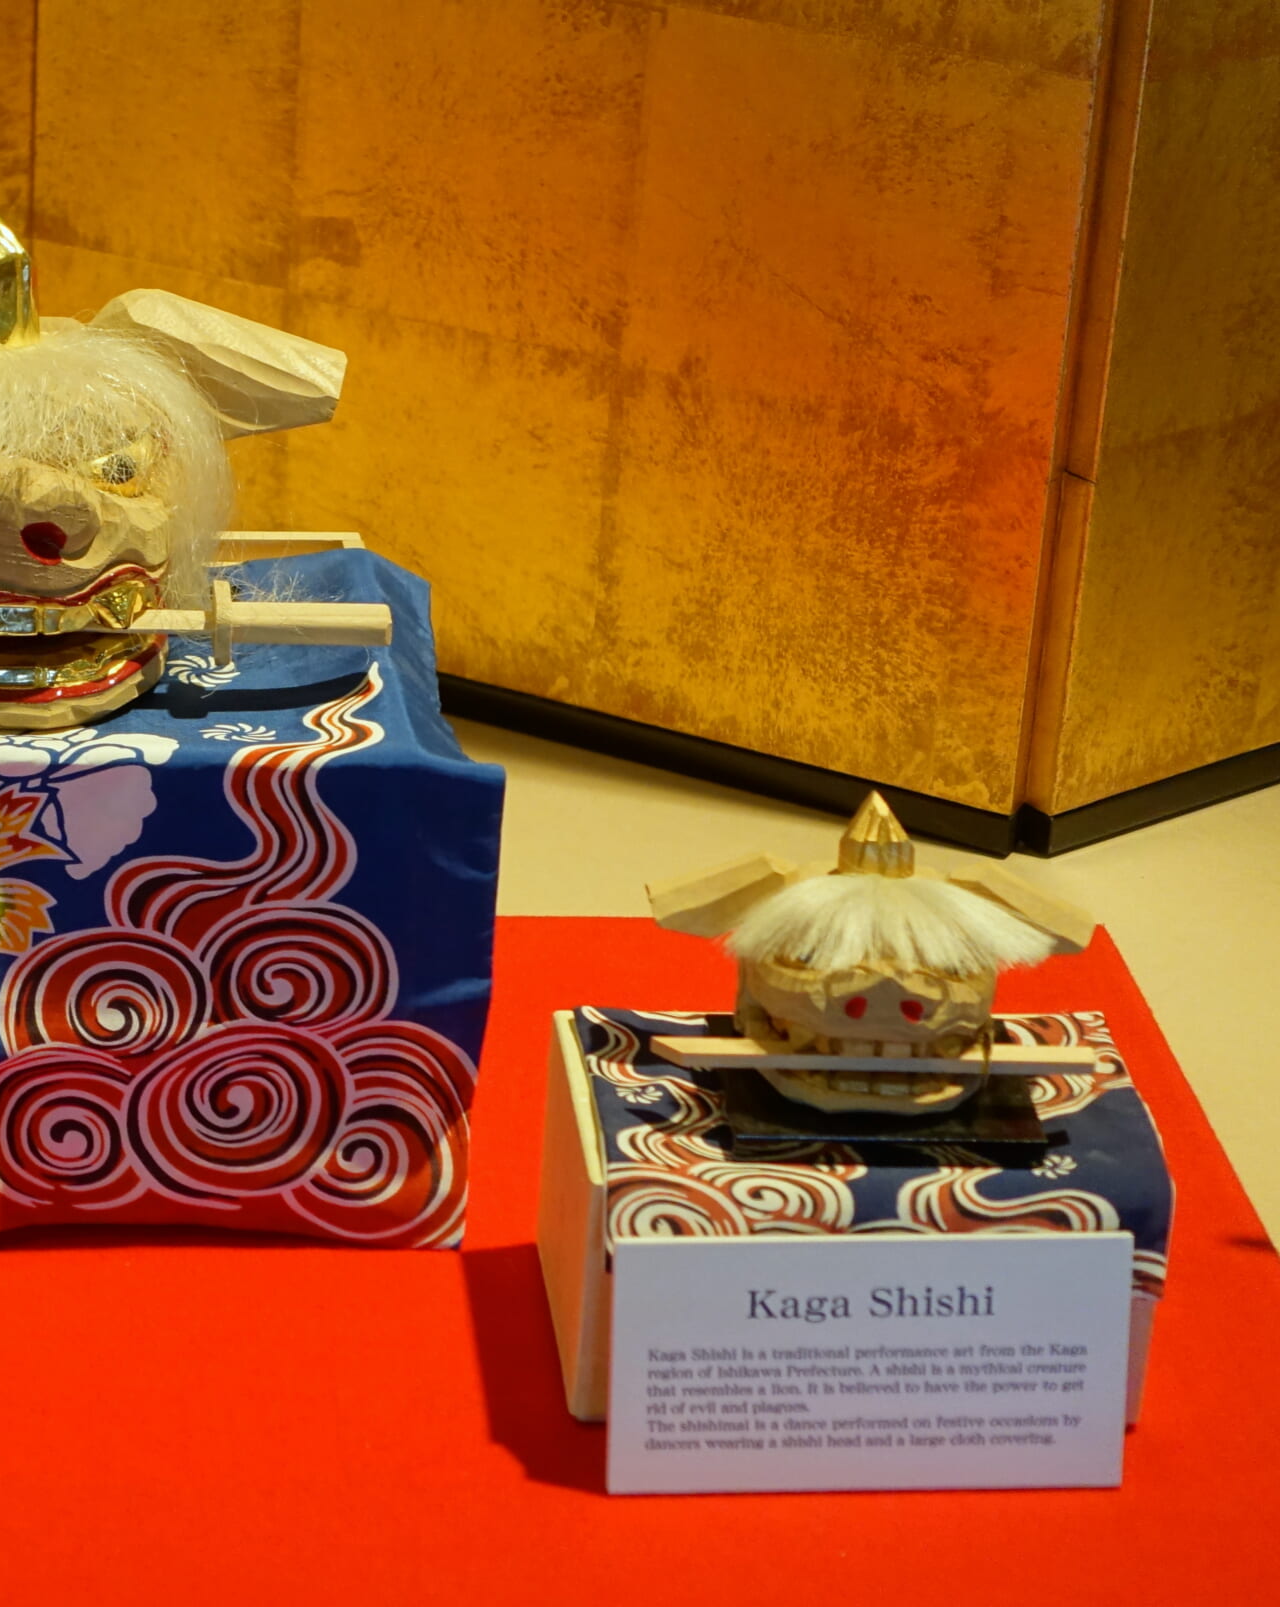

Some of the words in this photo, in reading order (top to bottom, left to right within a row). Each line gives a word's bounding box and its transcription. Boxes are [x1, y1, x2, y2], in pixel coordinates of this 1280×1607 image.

[748, 1290, 851, 1323] Kaga
[869, 1285, 994, 1317] Shishi
[648, 1349, 686, 1362] Kaga
[691, 1348, 737, 1360] Shishi
[742, 1348, 753, 1360] is
[758, 1350, 766, 1360] a
[772, 1346, 849, 1360] traditional
[854, 1346, 946, 1359] performance
[953, 1345, 973, 1357] art
[980, 1344, 1015, 1357] from
[1020, 1344, 1044, 1356] the
[1049, 1344, 1087, 1357] Kaga
[648, 1366, 693, 1380] region
[697, 1366, 711, 1378] of
[718, 1365, 782, 1378] Ishikawa
[787, 1365, 864, 1378] Prefecture.
[870, 1364, 880, 1376] A
[886, 1364, 926, 1375] shishi
[931, 1363, 942, 1375] is
[947, 1366, 955, 1375] a
[960, 1362, 1022, 1376] mythical
[1027, 1362, 1087, 1373] creature
[647, 1384, 676, 1397] that
[682, 1384, 753, 1396] resembles
[758, 1386, 766, 1395] a
[771, 1383, 801, 1395] lion.
[808, 1383, 818, 1394] It
[823, 1382, 834, 1394] is
[839, 1381, 900, 1393] believed
[905, 1382, 919, 1392] to
[924, 1381, 958, 1392] have
[964, 1380, 987, 1392] the
[992, 1382, 1037, 1393] power
[1043, 1380, 1057, 1391] to
[1062, 1380, 1084, 1392] get
[646, 1403, 667, 1415] rid
[670, 1402, 685, 1414] of
[689, 1402, 716, 1414] evil
[721, 1401, 748, 1414] and
[648, 1420, 676, 1433] The
[755, 1419, 766, 1431] is
[771, 1421, 778, 1430] a
[784, 1419, 826, 1430] dance
[832, 1417, 908, 1430] performed
[913, 1419, 931, 1428] on
[936, 1416, 985, 1428] festive
[989, 1415, 1058, 1427] occasions
[1064, 1414, 1082, 1427] by
[645, 1438, 700, 1450] dancers
[705, 1437, 764, 1450] wearing
[768, 1439, 776, 1448] a
[782, 1435, 823, 1448] shishi
[827, 1435, 861, 1447] head
[866, 1434, 892, 1446] and
[896, 1437, 904, 1446] a
[910, 1434, 946, 1447] large
[950, 1433, 985, 1445] cloth
[990, 1433, 1056, 1446] covering.
